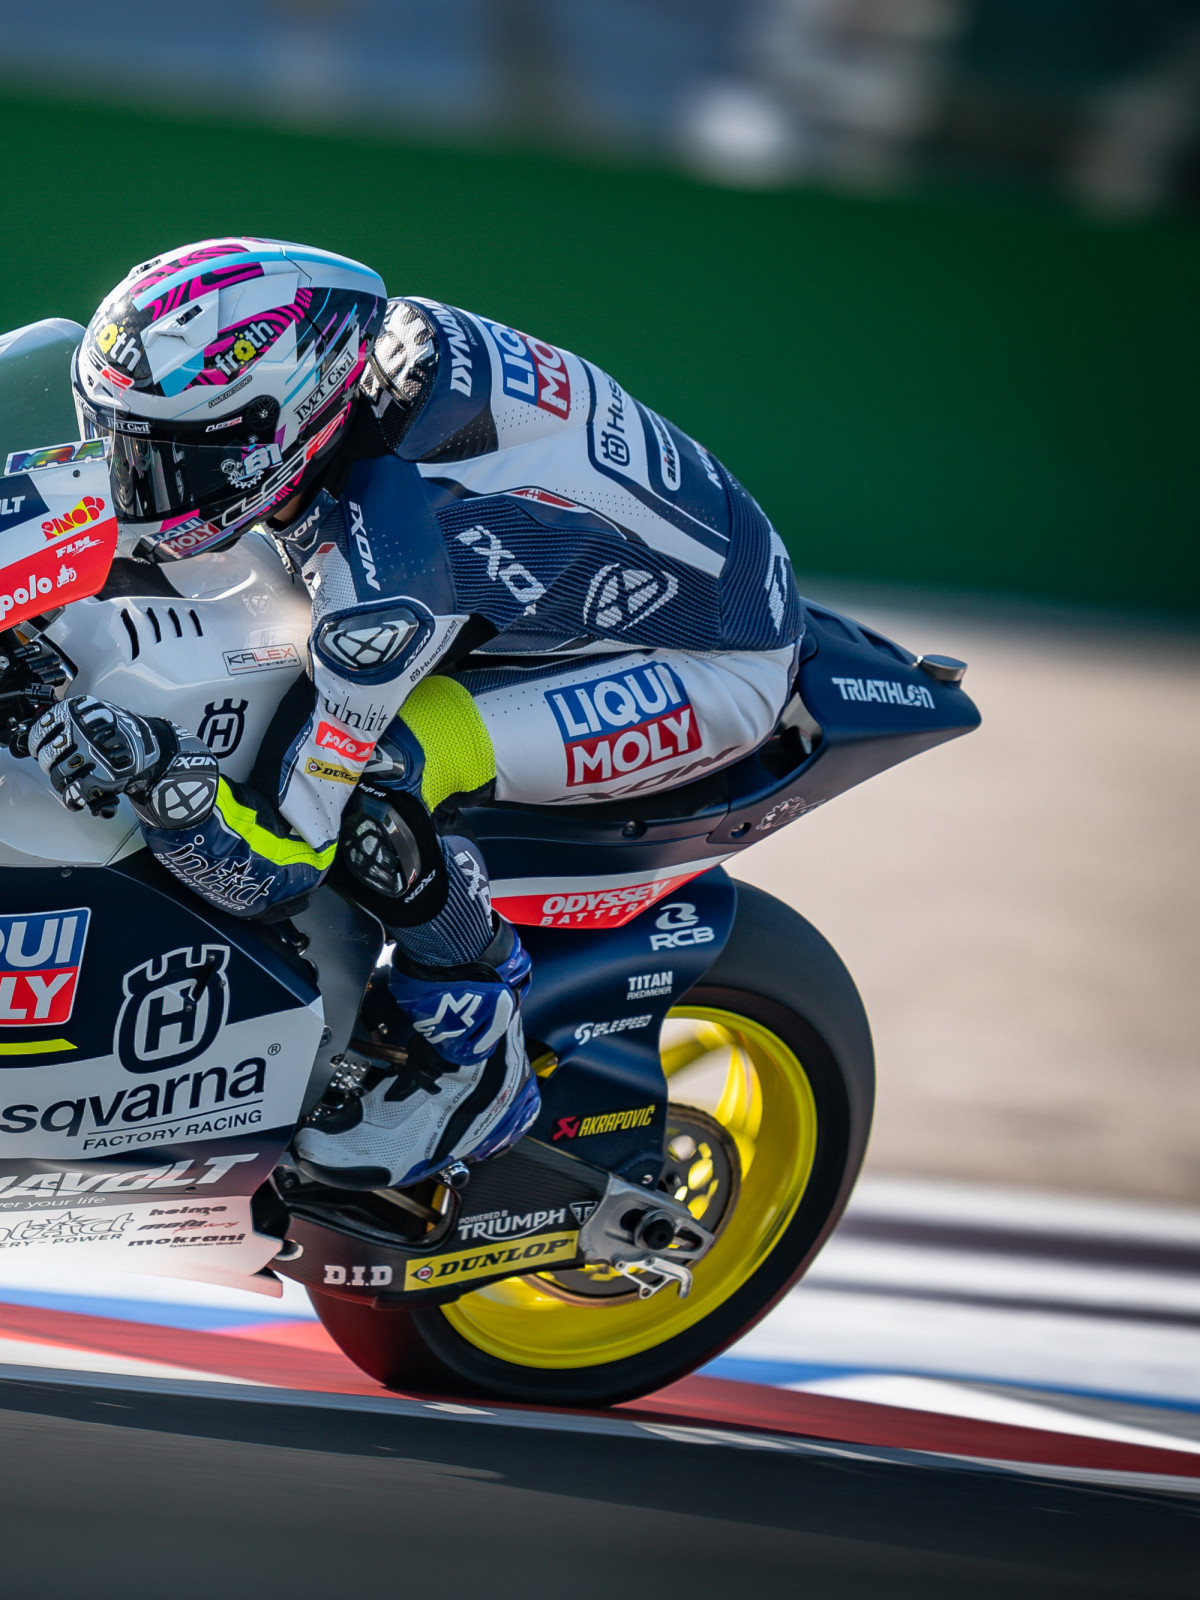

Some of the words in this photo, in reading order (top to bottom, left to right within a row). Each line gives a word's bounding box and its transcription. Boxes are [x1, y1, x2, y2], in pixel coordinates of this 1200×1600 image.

[214, 321, 274, 376] froth
[422, 302, 472, 397] DYNAV
[480, 316, 535, 397] LIQ
[327, 353, 355, 387] Civil
[526, 334, 568, 412] MO
[126, 423, 149, 432] Civil
[243, 443, 284, 476] 81
[162, 523, 214, 550] MOLY
[283, 506, 320, 543] XON
[56, 536, 91, 558] FLM
[227, 647, 294, 665] KALEX
[420, 619, 458, 671] Husqvarna
[257, 658, 298, 668] engineering
[552, 664, 682, 737] LIQUI
[572, 708, 691, 783] MOLY
[321, 767, 360, 782] DUNLO
[153, 852, 200, 888] BATTERY
[203, 891, 246, 911] POWER
[542, 880, 670, 915] ODYSSEY
[649, 926, 715, 951] RCB
[628, 971, 674, 991] TITAN
[83, 1126, 178, 1151] FACTORY
[182, 1109, 262, 1140] RACING
[24, 1199, 75, 1210] your
[77, 1196, 106, 1205] life
[459, 1211, 500, 1225] POWERED
[53, 1233, 123, 1245] POWER
[128, 1234, 246, 1247] mokrani
[458, 1209, 567, 1241] TRIUMPH
[436, 1238, 570, 1278] DUNLOP
[324, 1264, 392, 1286] D.I.D
